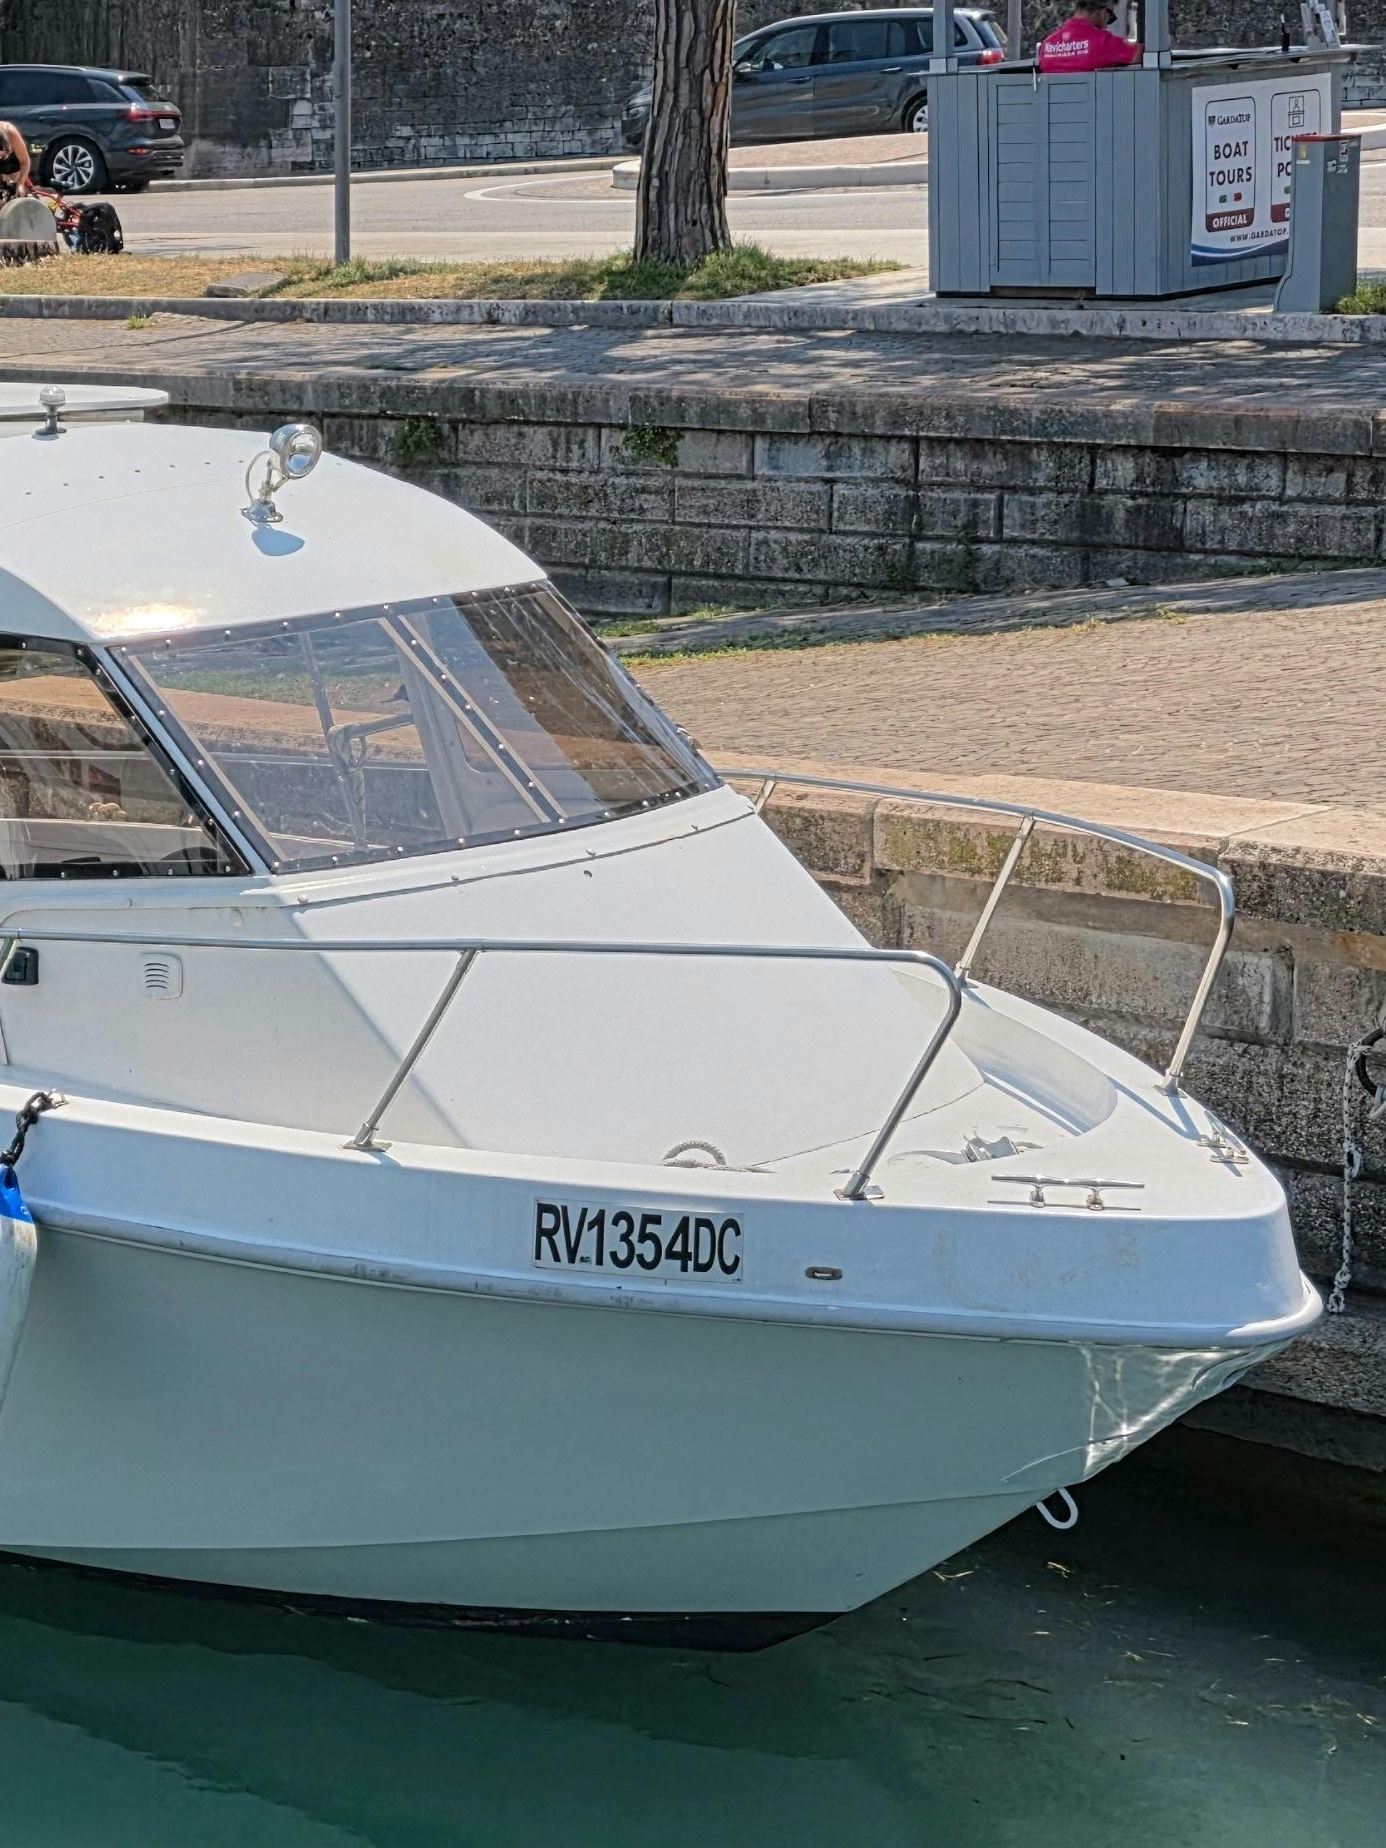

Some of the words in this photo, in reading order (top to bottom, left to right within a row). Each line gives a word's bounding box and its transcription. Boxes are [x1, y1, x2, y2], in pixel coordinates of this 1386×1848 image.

[1214, 141, 1249, 160] BOAT
[1209, 166, 1253, 187] TOURS
[1212, 214, 1248, 229] OFFICIAL
[1230, 227, 1289, 242] WWW.GARDATOP.
